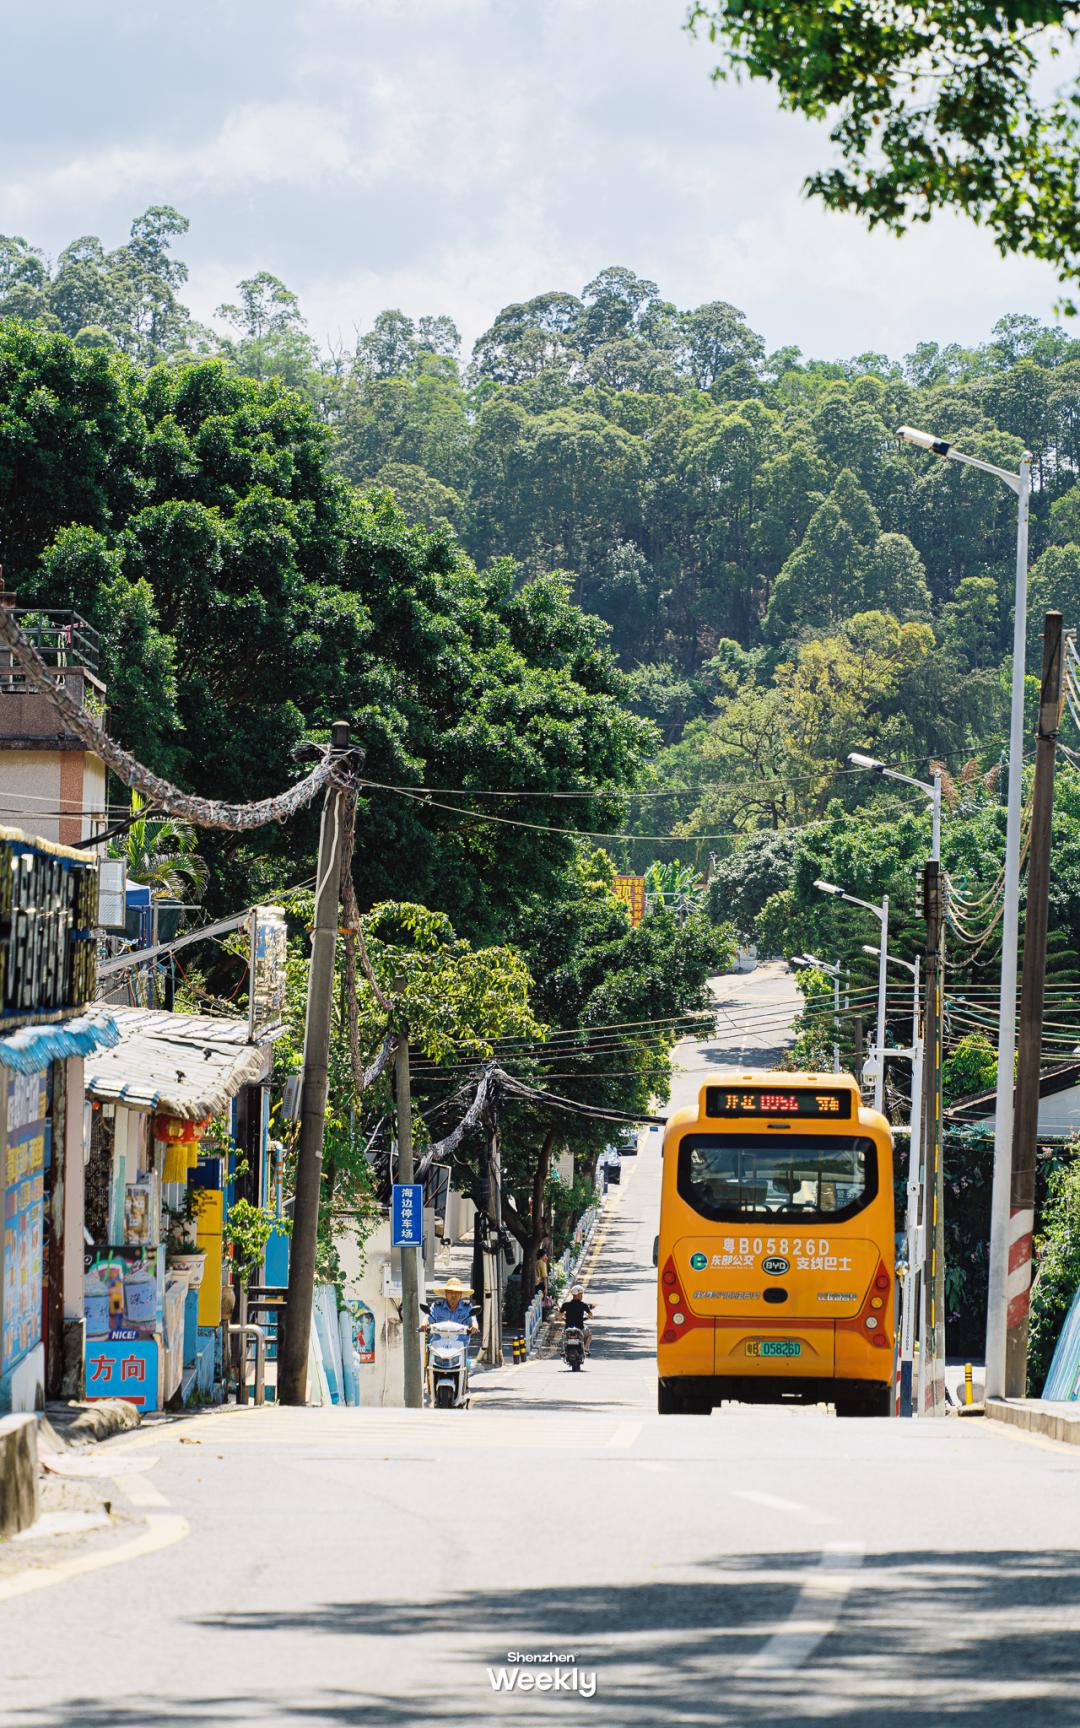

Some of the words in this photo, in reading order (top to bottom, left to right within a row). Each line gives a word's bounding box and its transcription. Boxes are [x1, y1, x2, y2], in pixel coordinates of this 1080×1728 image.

[401, 1188, 413, 1239] 海边停车场
[711, 1255, 755, 1266] 东部公交
[766, 1260, 786, 1270] BYD
[796, 1256, 852, 1271] 支线巴士
[112, 1331, 137, 1340] NICE!
[90, 1354, 146, 1381] 方向
